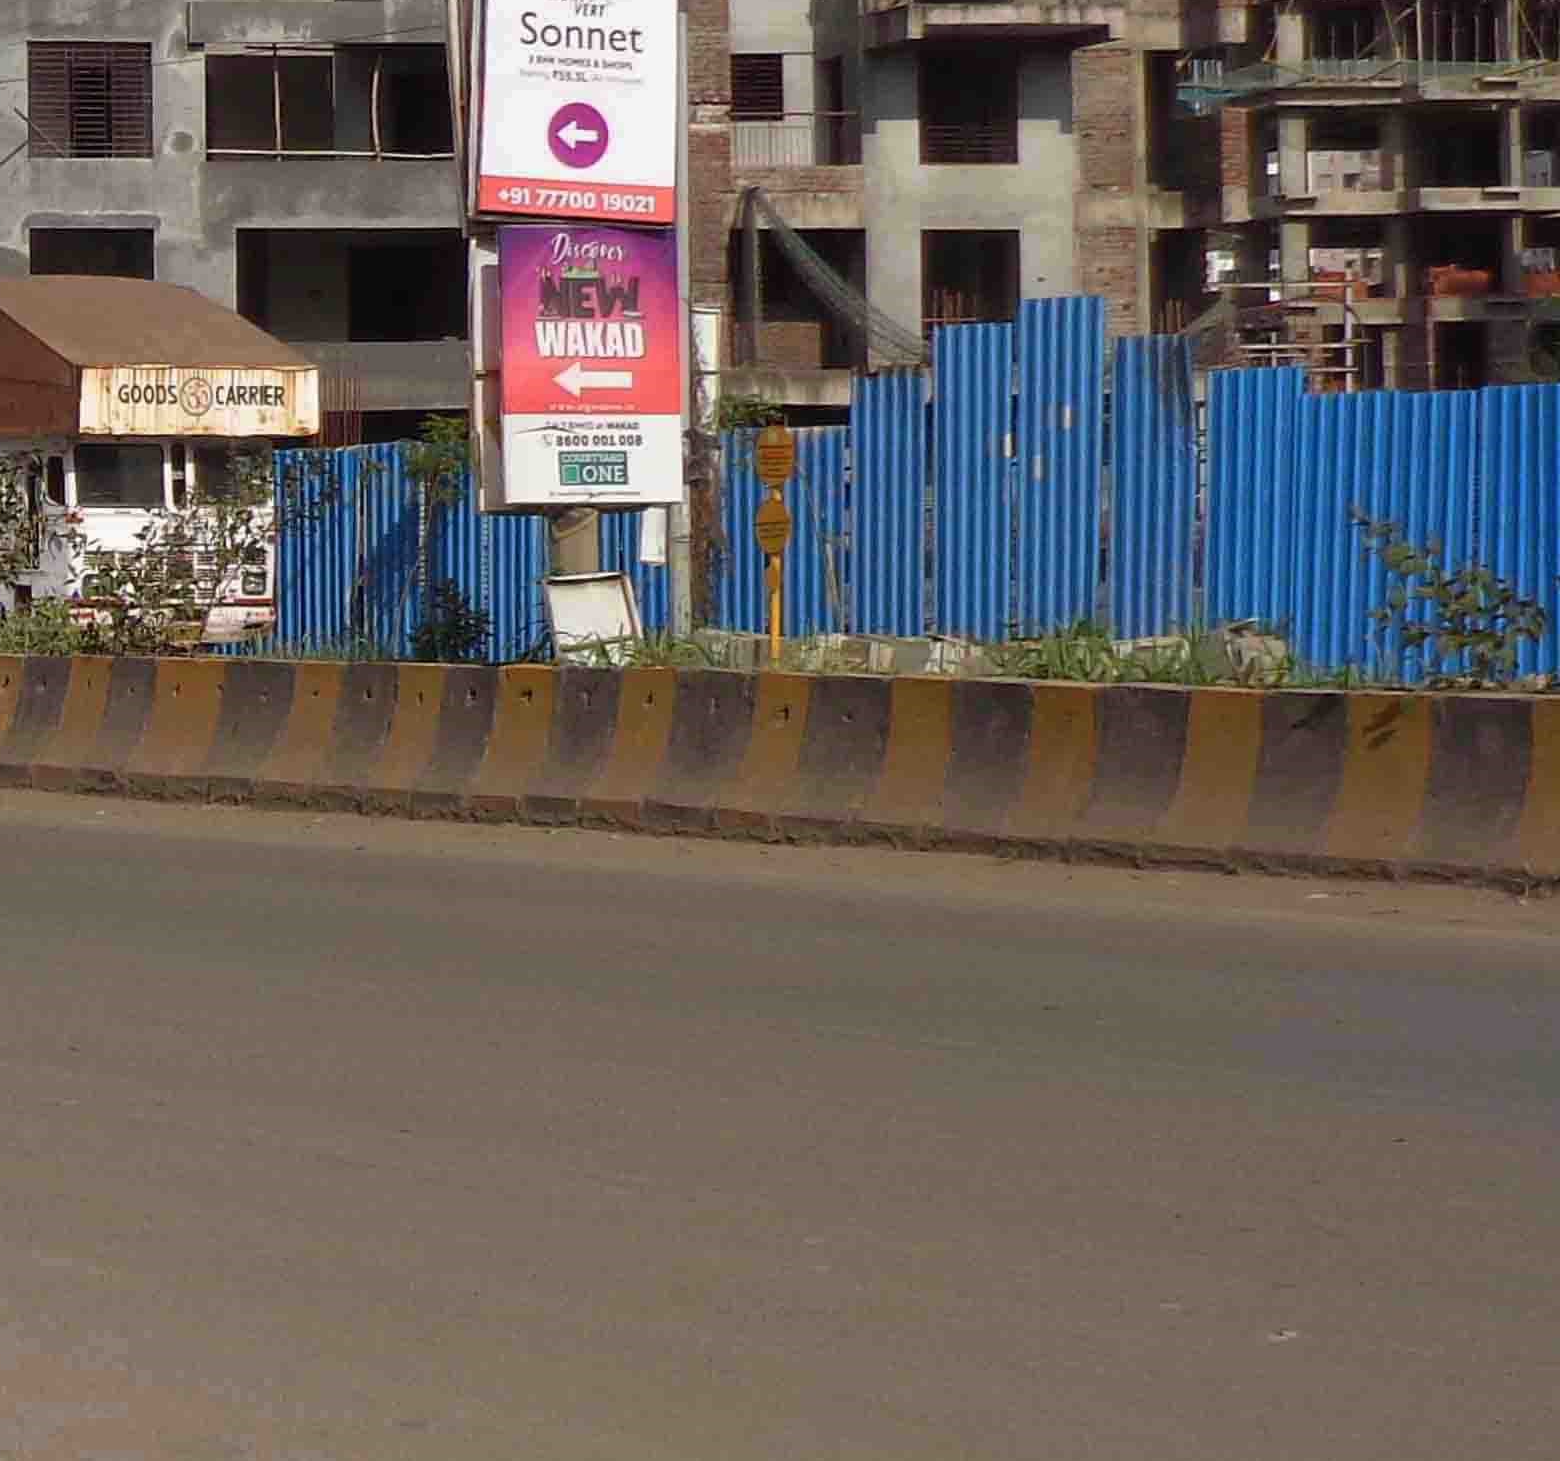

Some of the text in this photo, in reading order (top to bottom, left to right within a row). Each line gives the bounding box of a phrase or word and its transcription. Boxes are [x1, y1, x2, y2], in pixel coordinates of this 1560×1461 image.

[574, 2, 606, 18] VERT
[520, 11, 644, 54] Sonnet
[498, 187, 656, 212] +91 77700 19021
[551, 233, 625, 266] Discover
[539, 278, 642, 319] NEW
[535, 321, 646, 358] WAKAD
[118, 385, 285, 406] GOODS CARRIER
[582, 464, 625, 483] ONE
